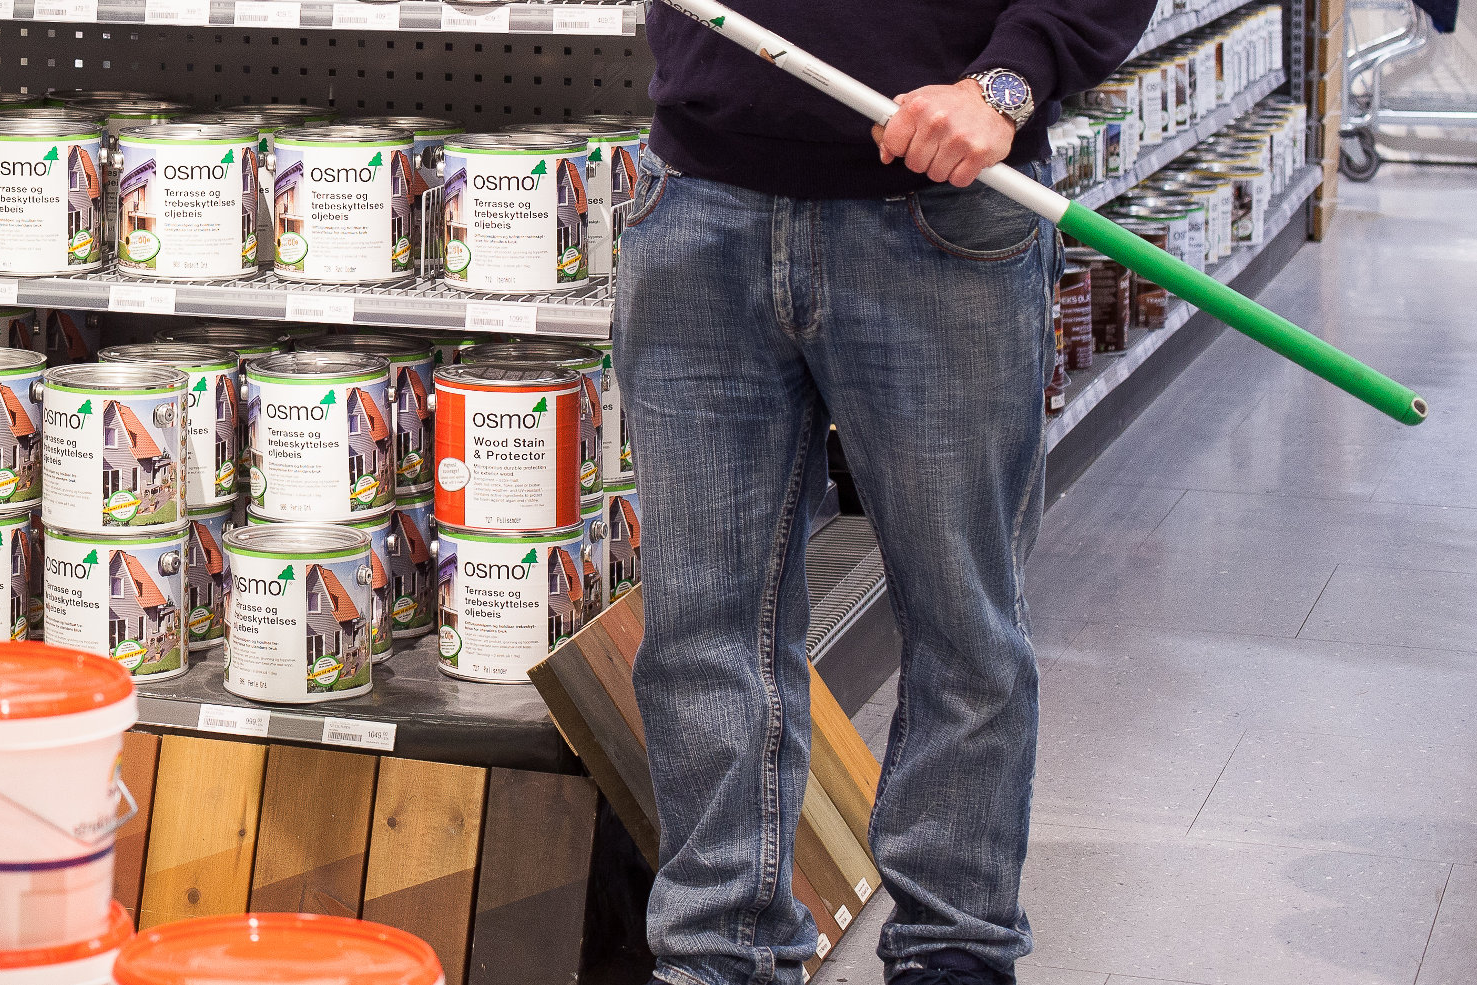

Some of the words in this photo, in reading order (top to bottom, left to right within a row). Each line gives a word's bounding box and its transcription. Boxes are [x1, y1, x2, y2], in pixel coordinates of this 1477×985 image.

[164, 163, 224, 180] osmo
[310, 166, 372, 183] osmo
[473, 174, 535, 191] osmo
[31, 186, 43, 196] og
[164, 189, 206, 198] Terrasse
[209, 191, 221, 200] og
[311, 191, 352, 200] Terrasse
[355, 192, 368, 202] og
[164, 198, 236, 208] trebeskyttelses
[311, 200, 384, 211] trebeskyttelses
[474, 199, 514, 209] Terrasse
[518, 201, 530, 210] og
[164, 209, 203, 219] oljebeis
[311, 211, 349, 222] oljebeis
[474, 209, 549, 219] trebeskyttelses
[474, 220, 511, 230] oljebeis
[266, 403, 324, 421] osmo
[473, 412, 536, 429] osmo
[268, 427, 305, 437] Terrasse
[308, 430, 321, 440] og
[268, 437, 340, 449] trebeskyttelses
[474, 436, 508, 448] Wood
[514, 437, 545, 447] Stain
[268, 449, 302, 459] oljebeis
[474, 450, 481, 459] &
[487, 451, 546, 461] Protector
[46, 557, 87, 579] osmo
[464, 561, 526, 580] osmo
[234, 574, 282, 596] osmo
[465, 586, 505, 597] Terrasse
[508, 590, 521, 599] og
[265, 606, 278, 615] og
